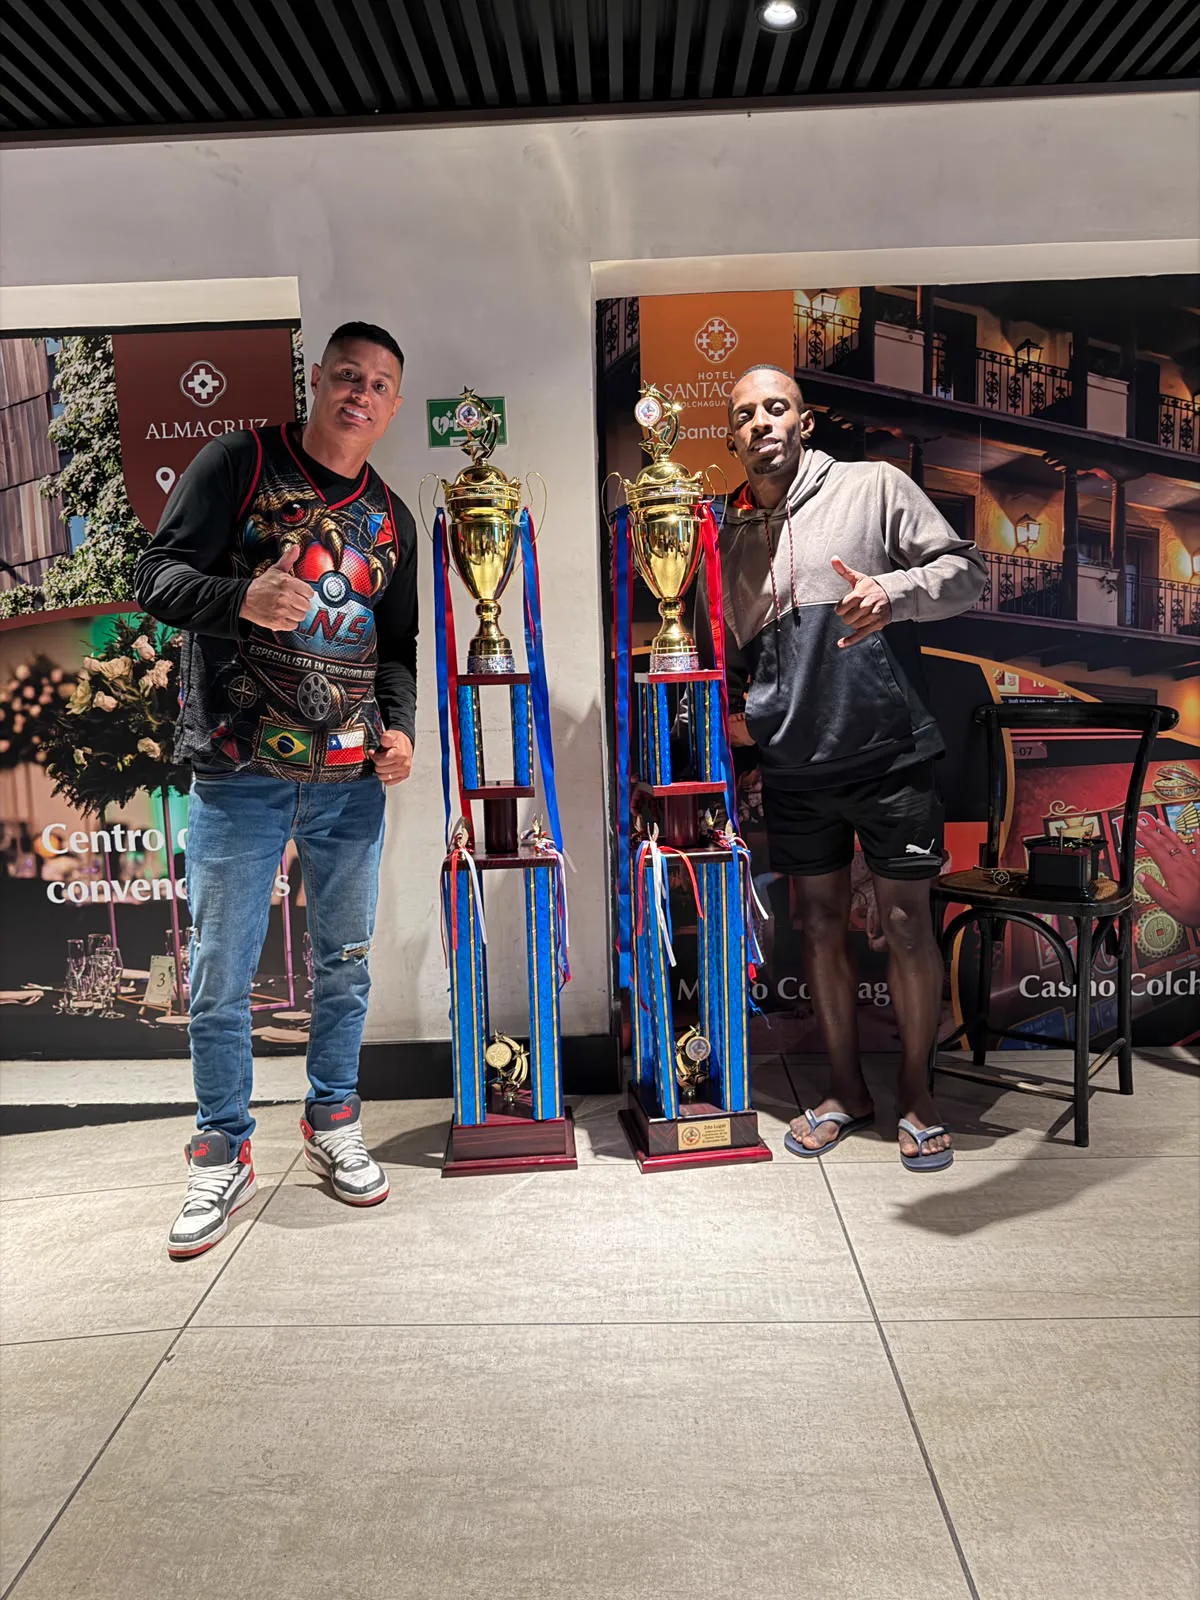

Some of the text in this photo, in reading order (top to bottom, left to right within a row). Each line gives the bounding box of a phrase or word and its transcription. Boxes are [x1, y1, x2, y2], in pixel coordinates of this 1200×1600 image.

[698, 371, 736, 380] HOTEL
[663, 380, 738, 400] SANTAC
[145, 418, 269, 440] ALMACRUZ
[679, 424, 729, 440] Santa
[248, 644, 312, 669] ESPECIALISTA
[314, 661, 325, 671] EM
[41, 823, 165, 855] Centro
[46, 874, 291, 904] convencs
[156, 972, 166, 988] 3
